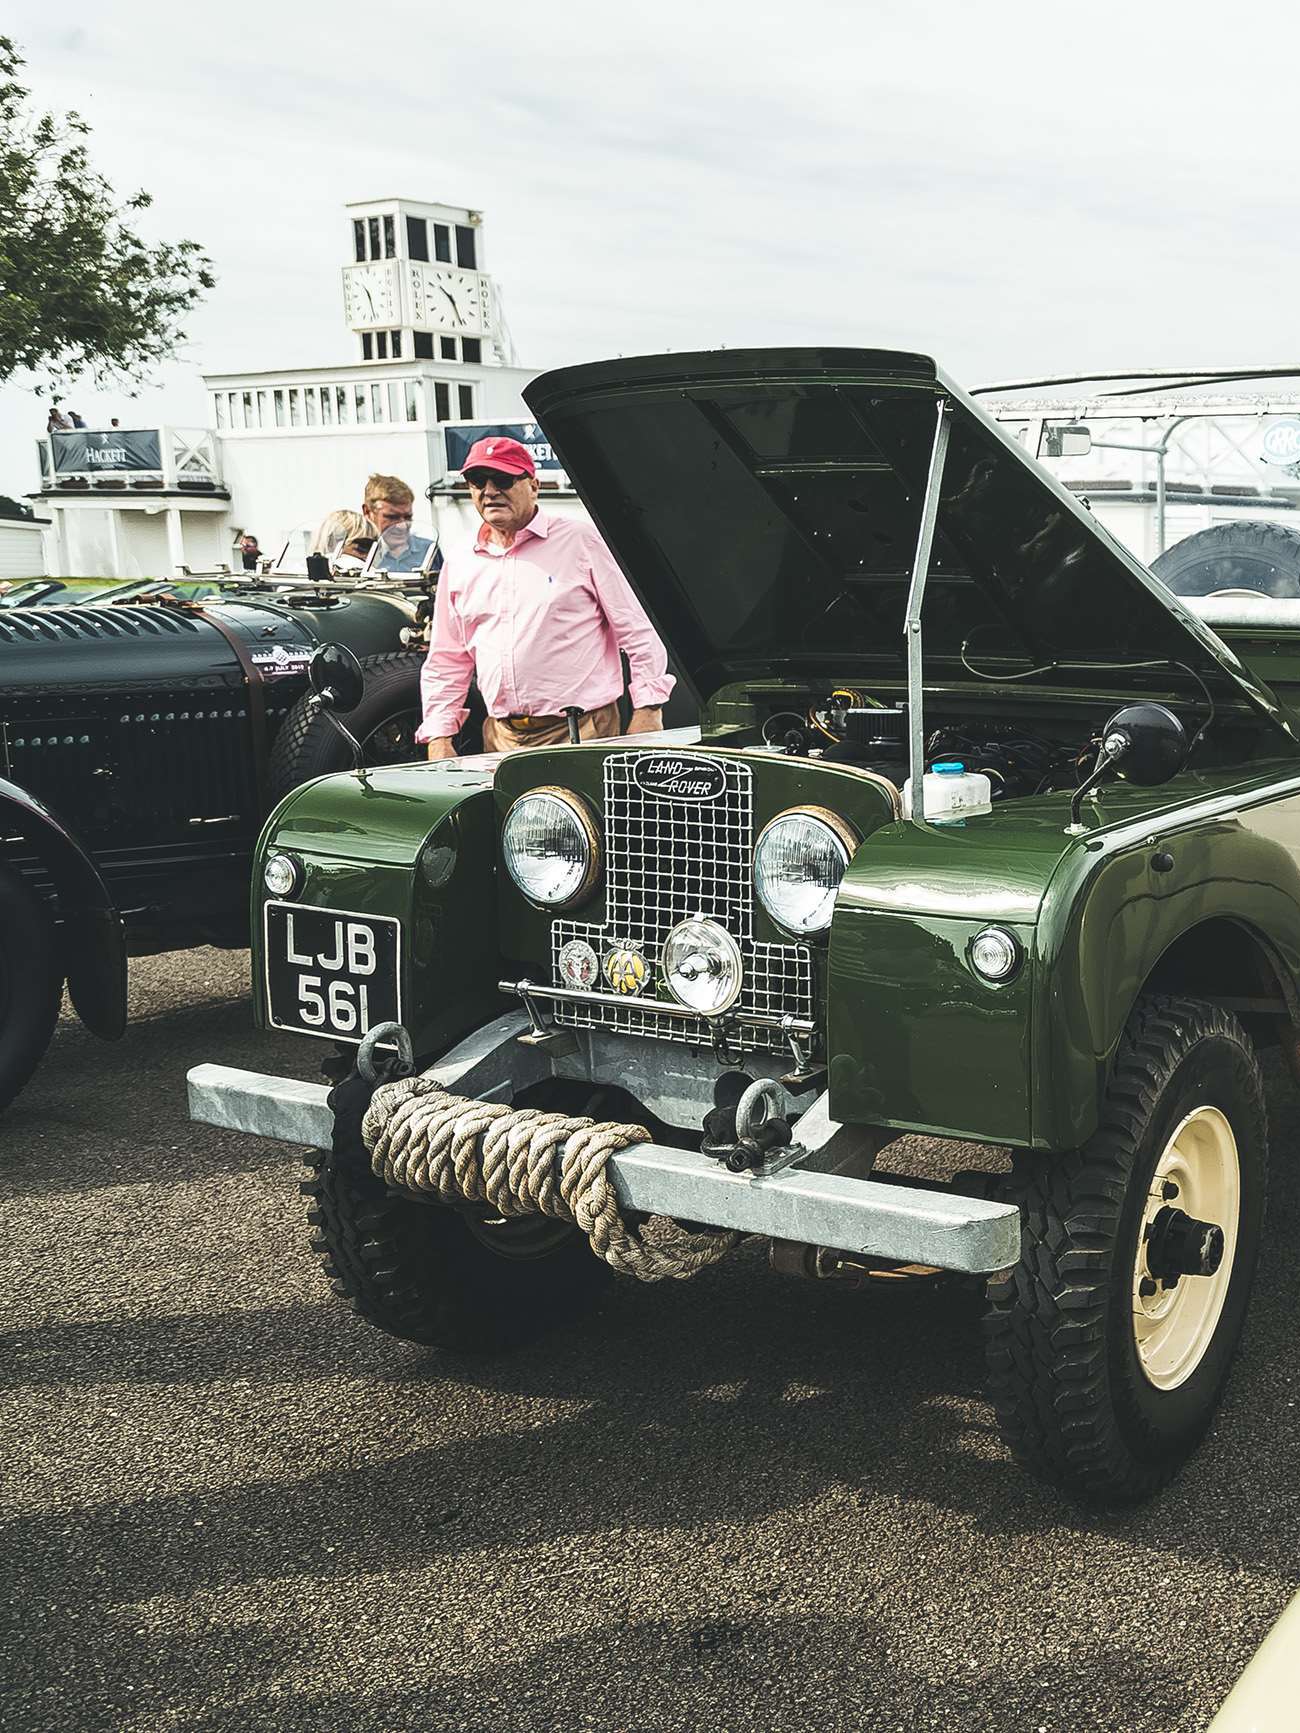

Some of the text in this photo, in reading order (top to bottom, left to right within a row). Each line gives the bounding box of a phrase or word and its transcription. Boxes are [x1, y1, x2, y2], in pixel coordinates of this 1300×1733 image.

[411, 269, 423, 320] ROLEX
[480, 279, 490, 329] ROLEX
[85, 447, 128, 463] HACKETT
[523, 443, 559, 461] KET
[647, 760, 683, 775] LAND
[668, 781, 712, 796] ROVER
[286, 913, 377, 976] LJB
[298, 974, 369, 1035] 561
